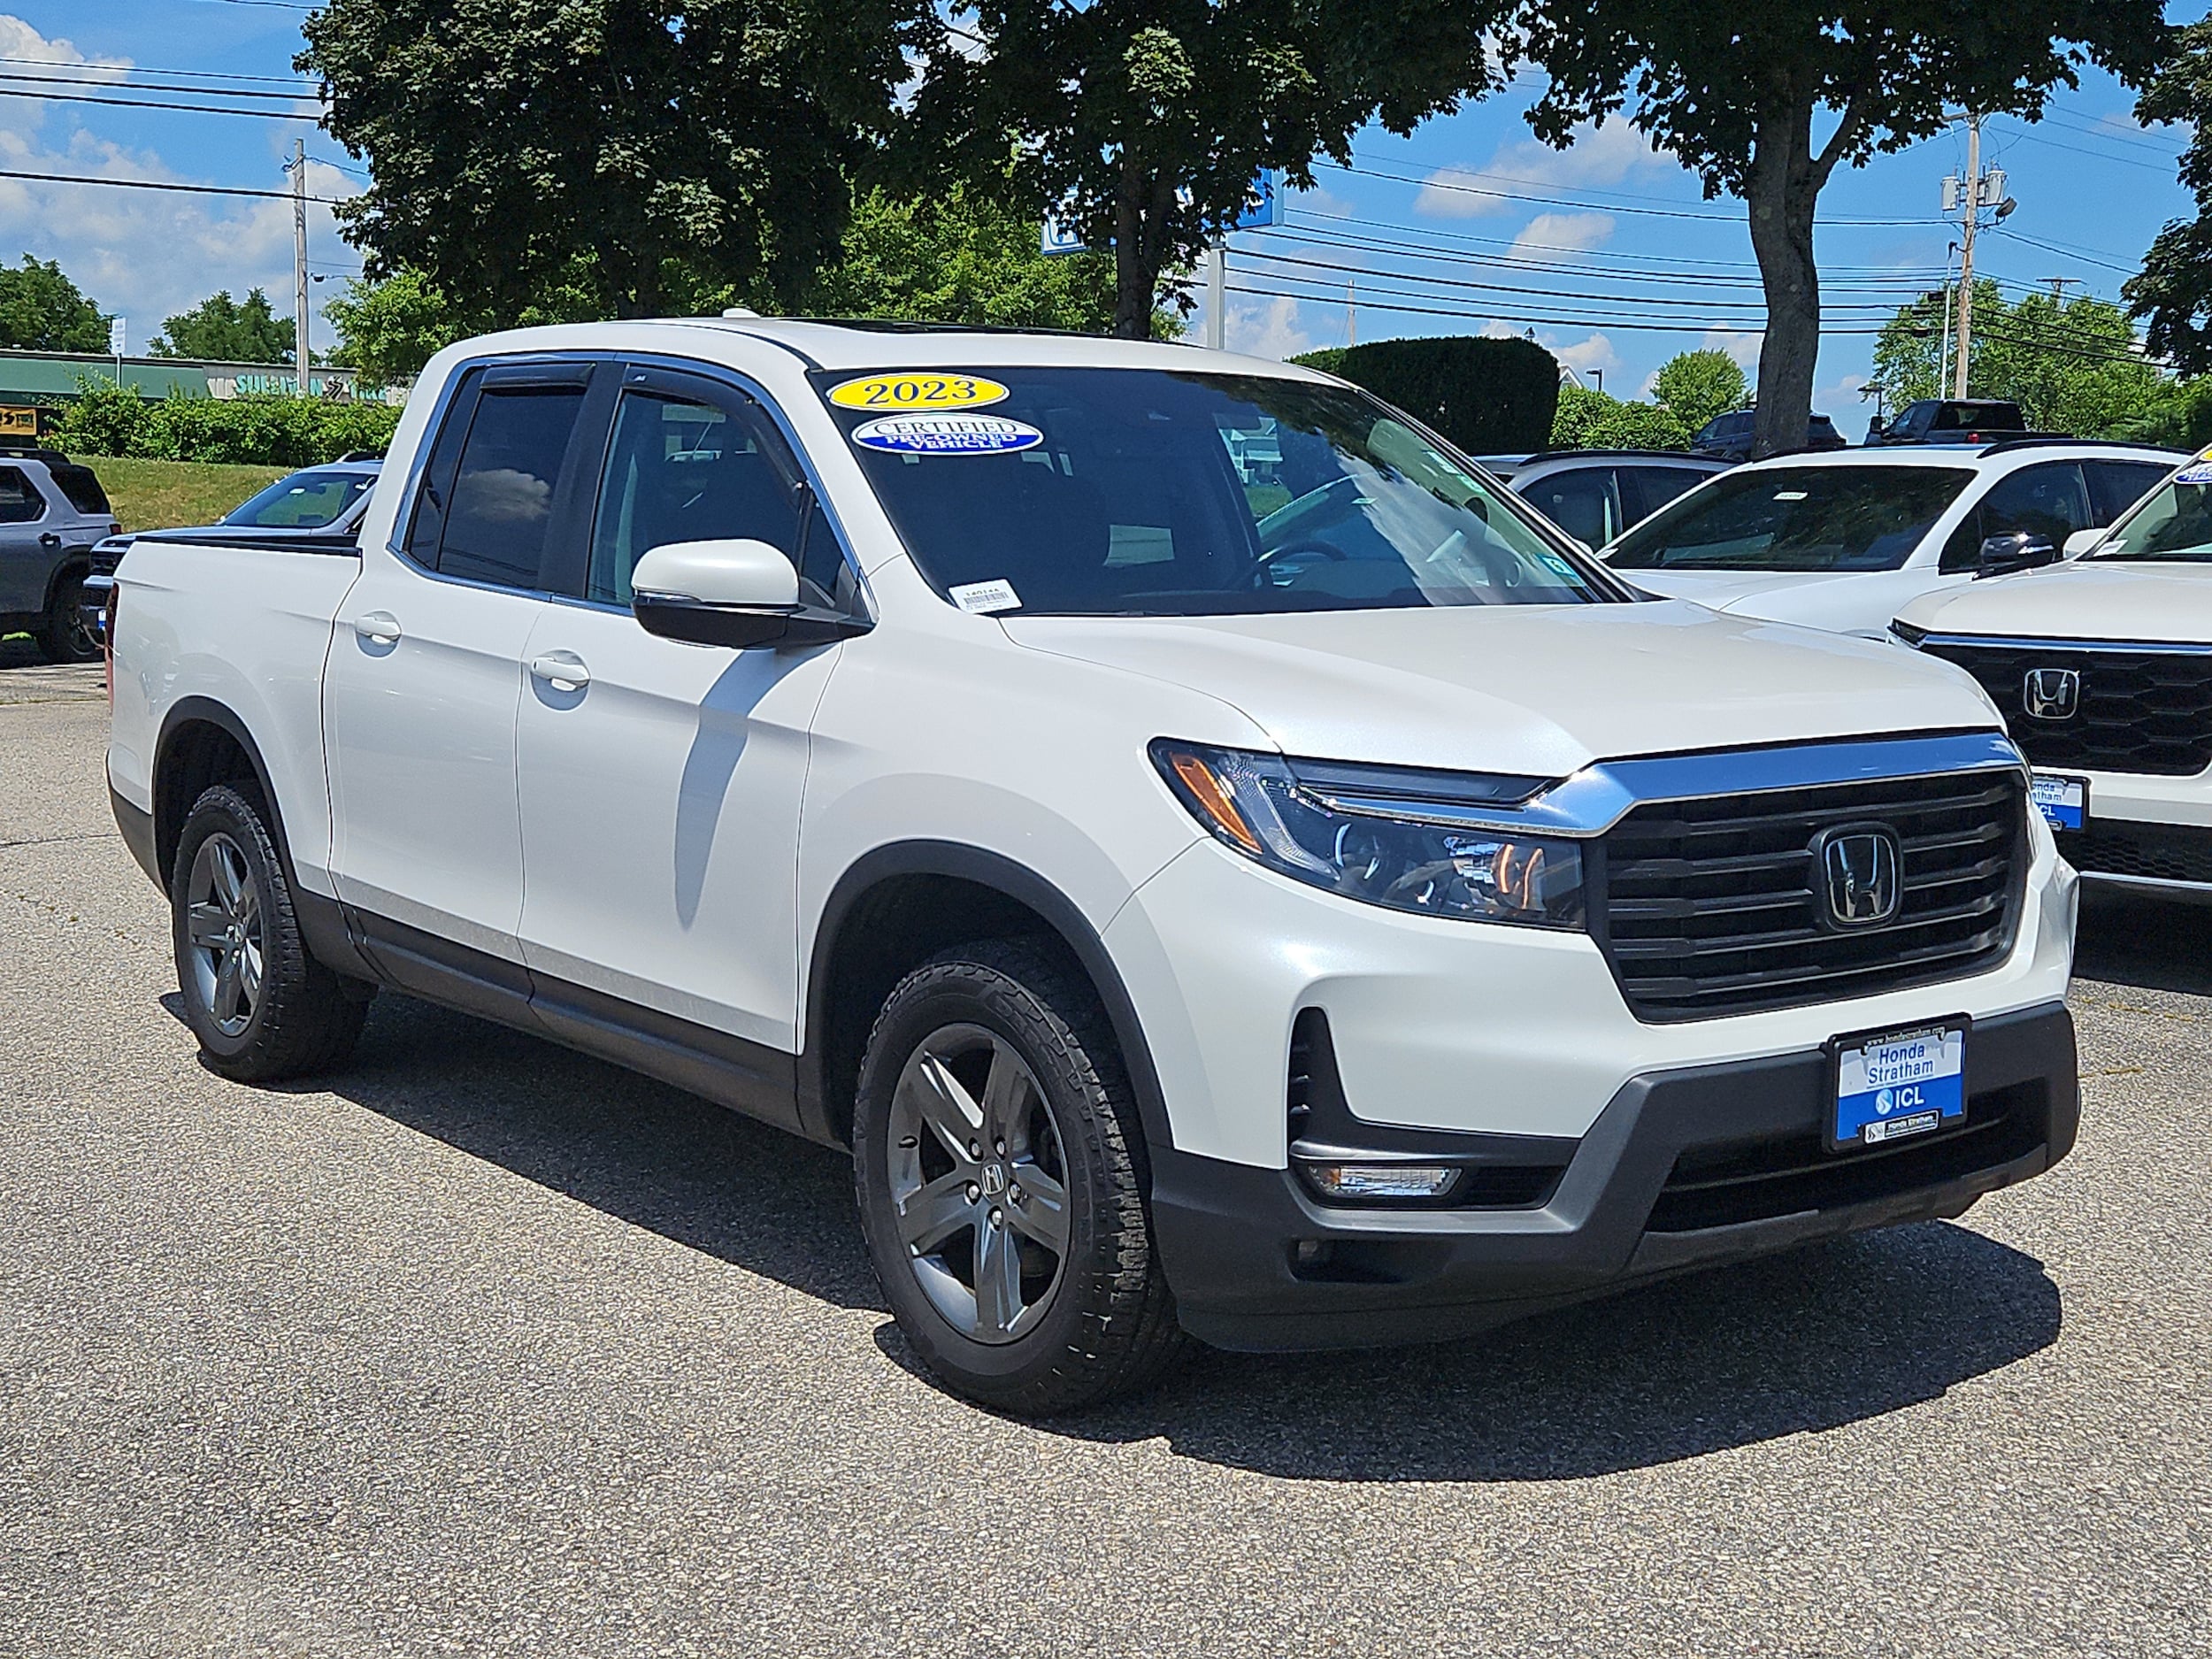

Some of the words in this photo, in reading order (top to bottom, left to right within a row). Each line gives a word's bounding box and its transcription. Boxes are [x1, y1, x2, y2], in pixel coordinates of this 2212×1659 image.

[235, 374, 322, 398] SULLIVN
[864, 380, 977, 405] 2023
[873, 420, 1018, 435] CERTIFIED
[885, 433, 1018, 444] PRE-OWNED
[906, 440, 1004, 449] VEHICLE
[2032, 783, 2055, 792] onda
[2039, 804, 2055, 816] CL
[1878, 1042, 1925, 1065] Honda
[1868, 1060, 1933, 1084] Stratham
[1895, 1086, 1925, 1110] ICL
